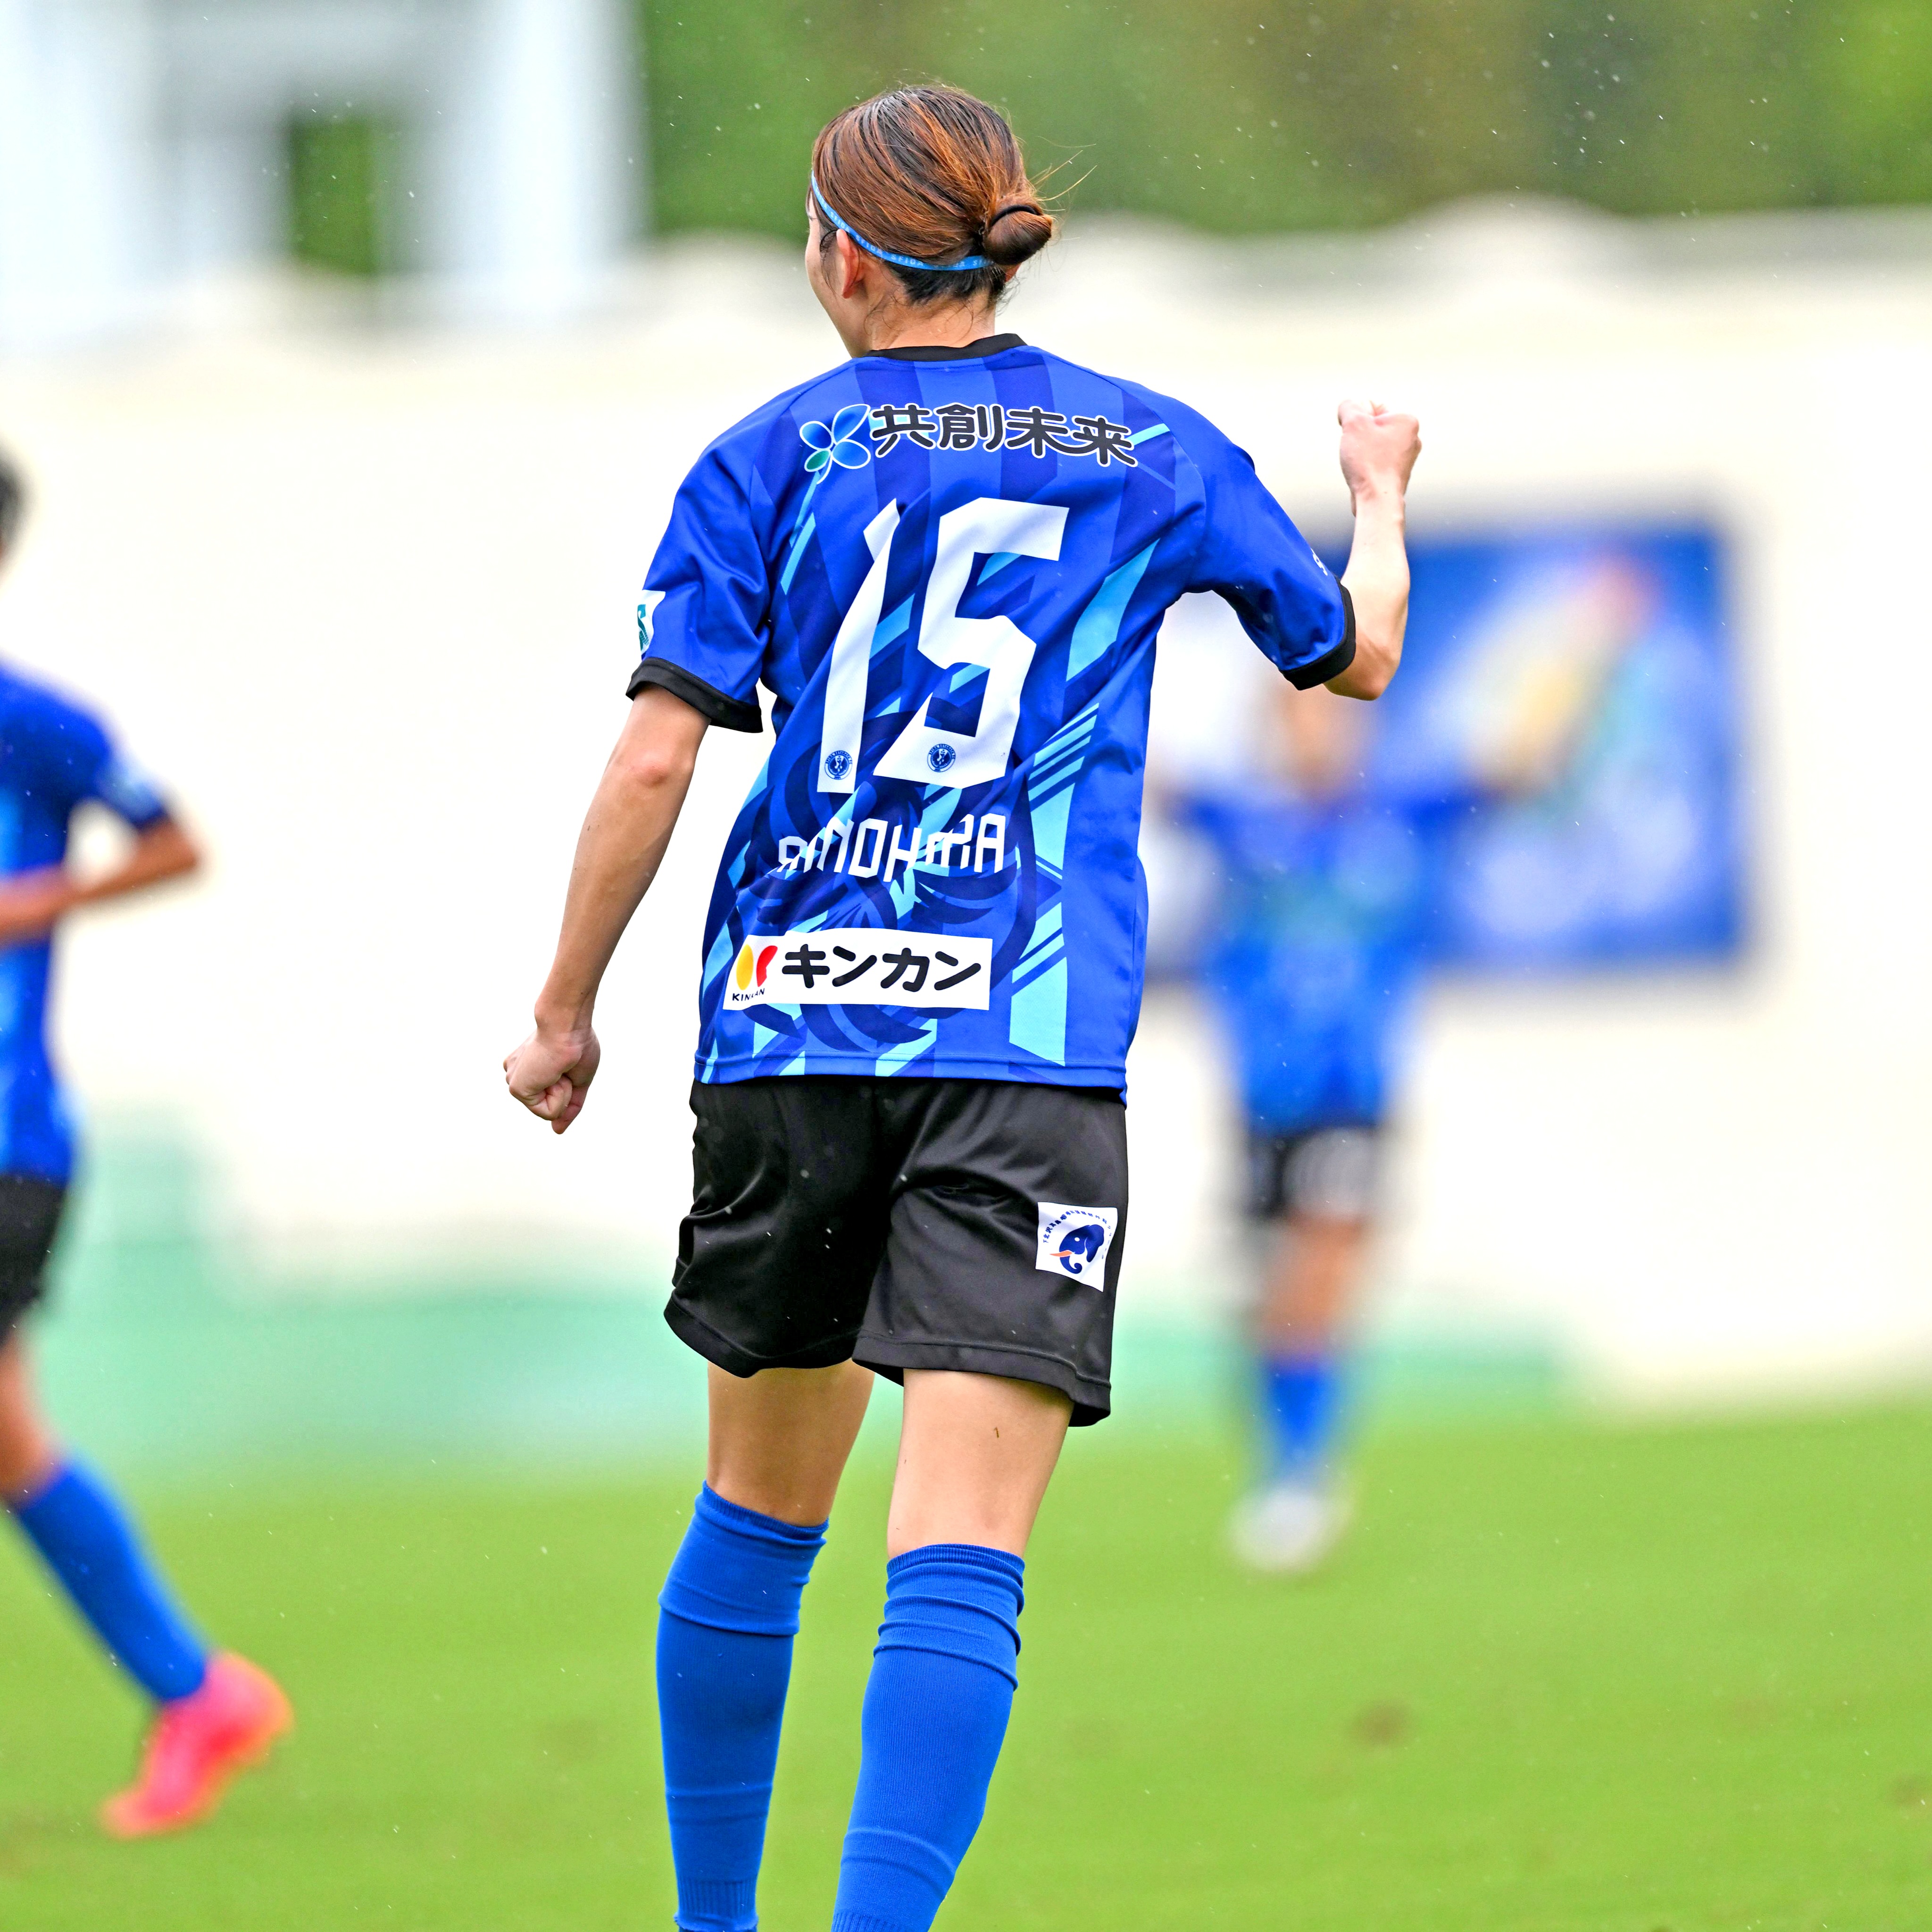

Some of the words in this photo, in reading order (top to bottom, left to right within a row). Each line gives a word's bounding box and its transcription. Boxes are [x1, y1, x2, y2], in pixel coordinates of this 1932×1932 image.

[891, 254, 924, 266] SFIDA
[870, 402, 1138, 467] 共創未来
[817, 497, 1070, 793] 15
[782, 943, 982, 992] キンカン
